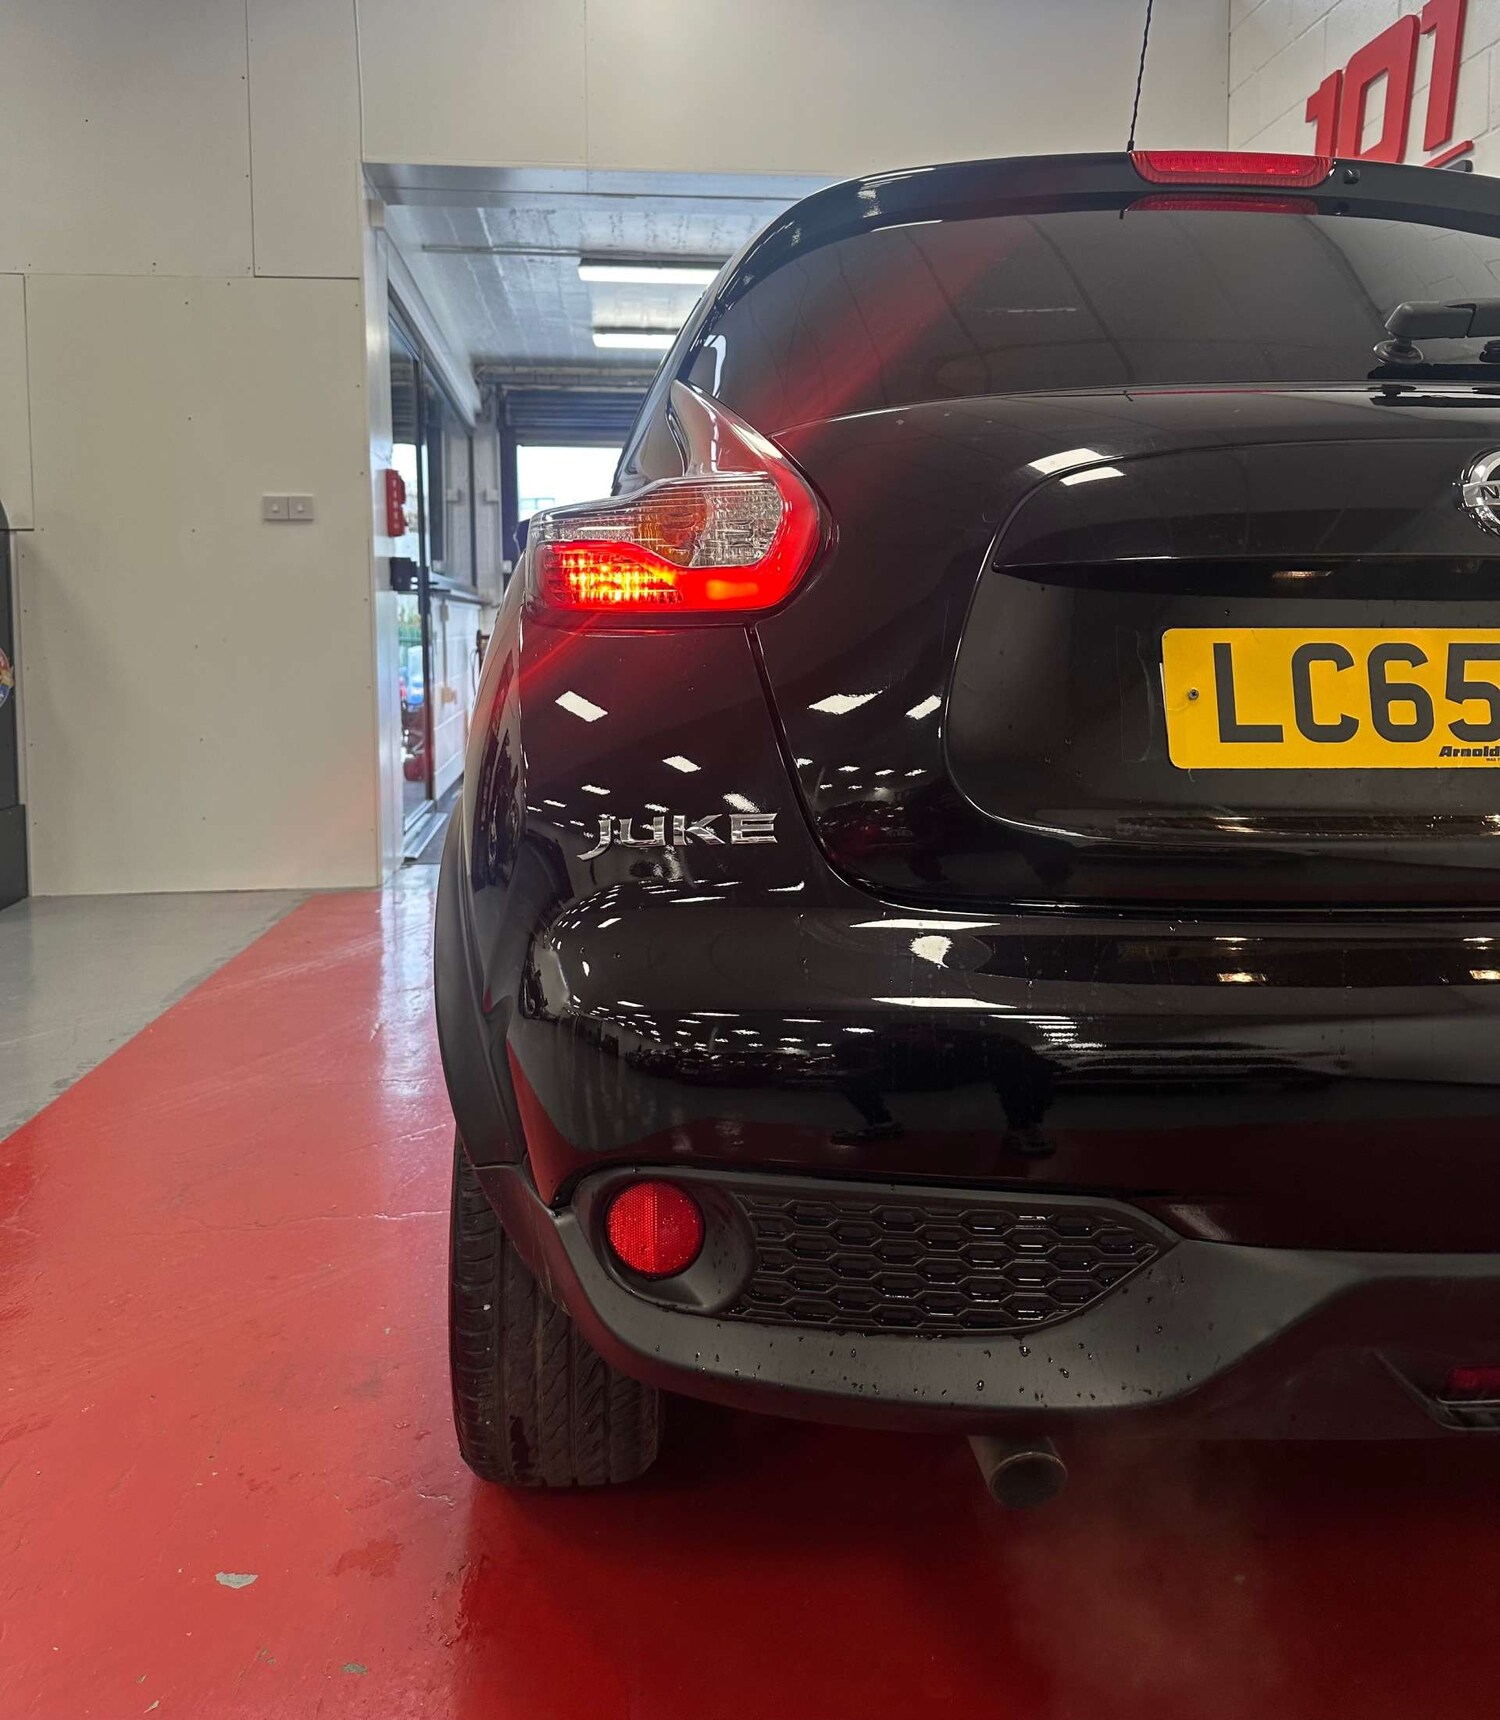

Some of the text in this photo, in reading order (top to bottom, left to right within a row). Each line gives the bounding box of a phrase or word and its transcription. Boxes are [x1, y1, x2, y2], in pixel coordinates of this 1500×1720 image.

[1305, 0, 1467, 163] 101
[1212, 642, 1500, 743] LC65
[1438, 745, 1500, 757] Arnold
[577, 813, 778, 861] JUKE
